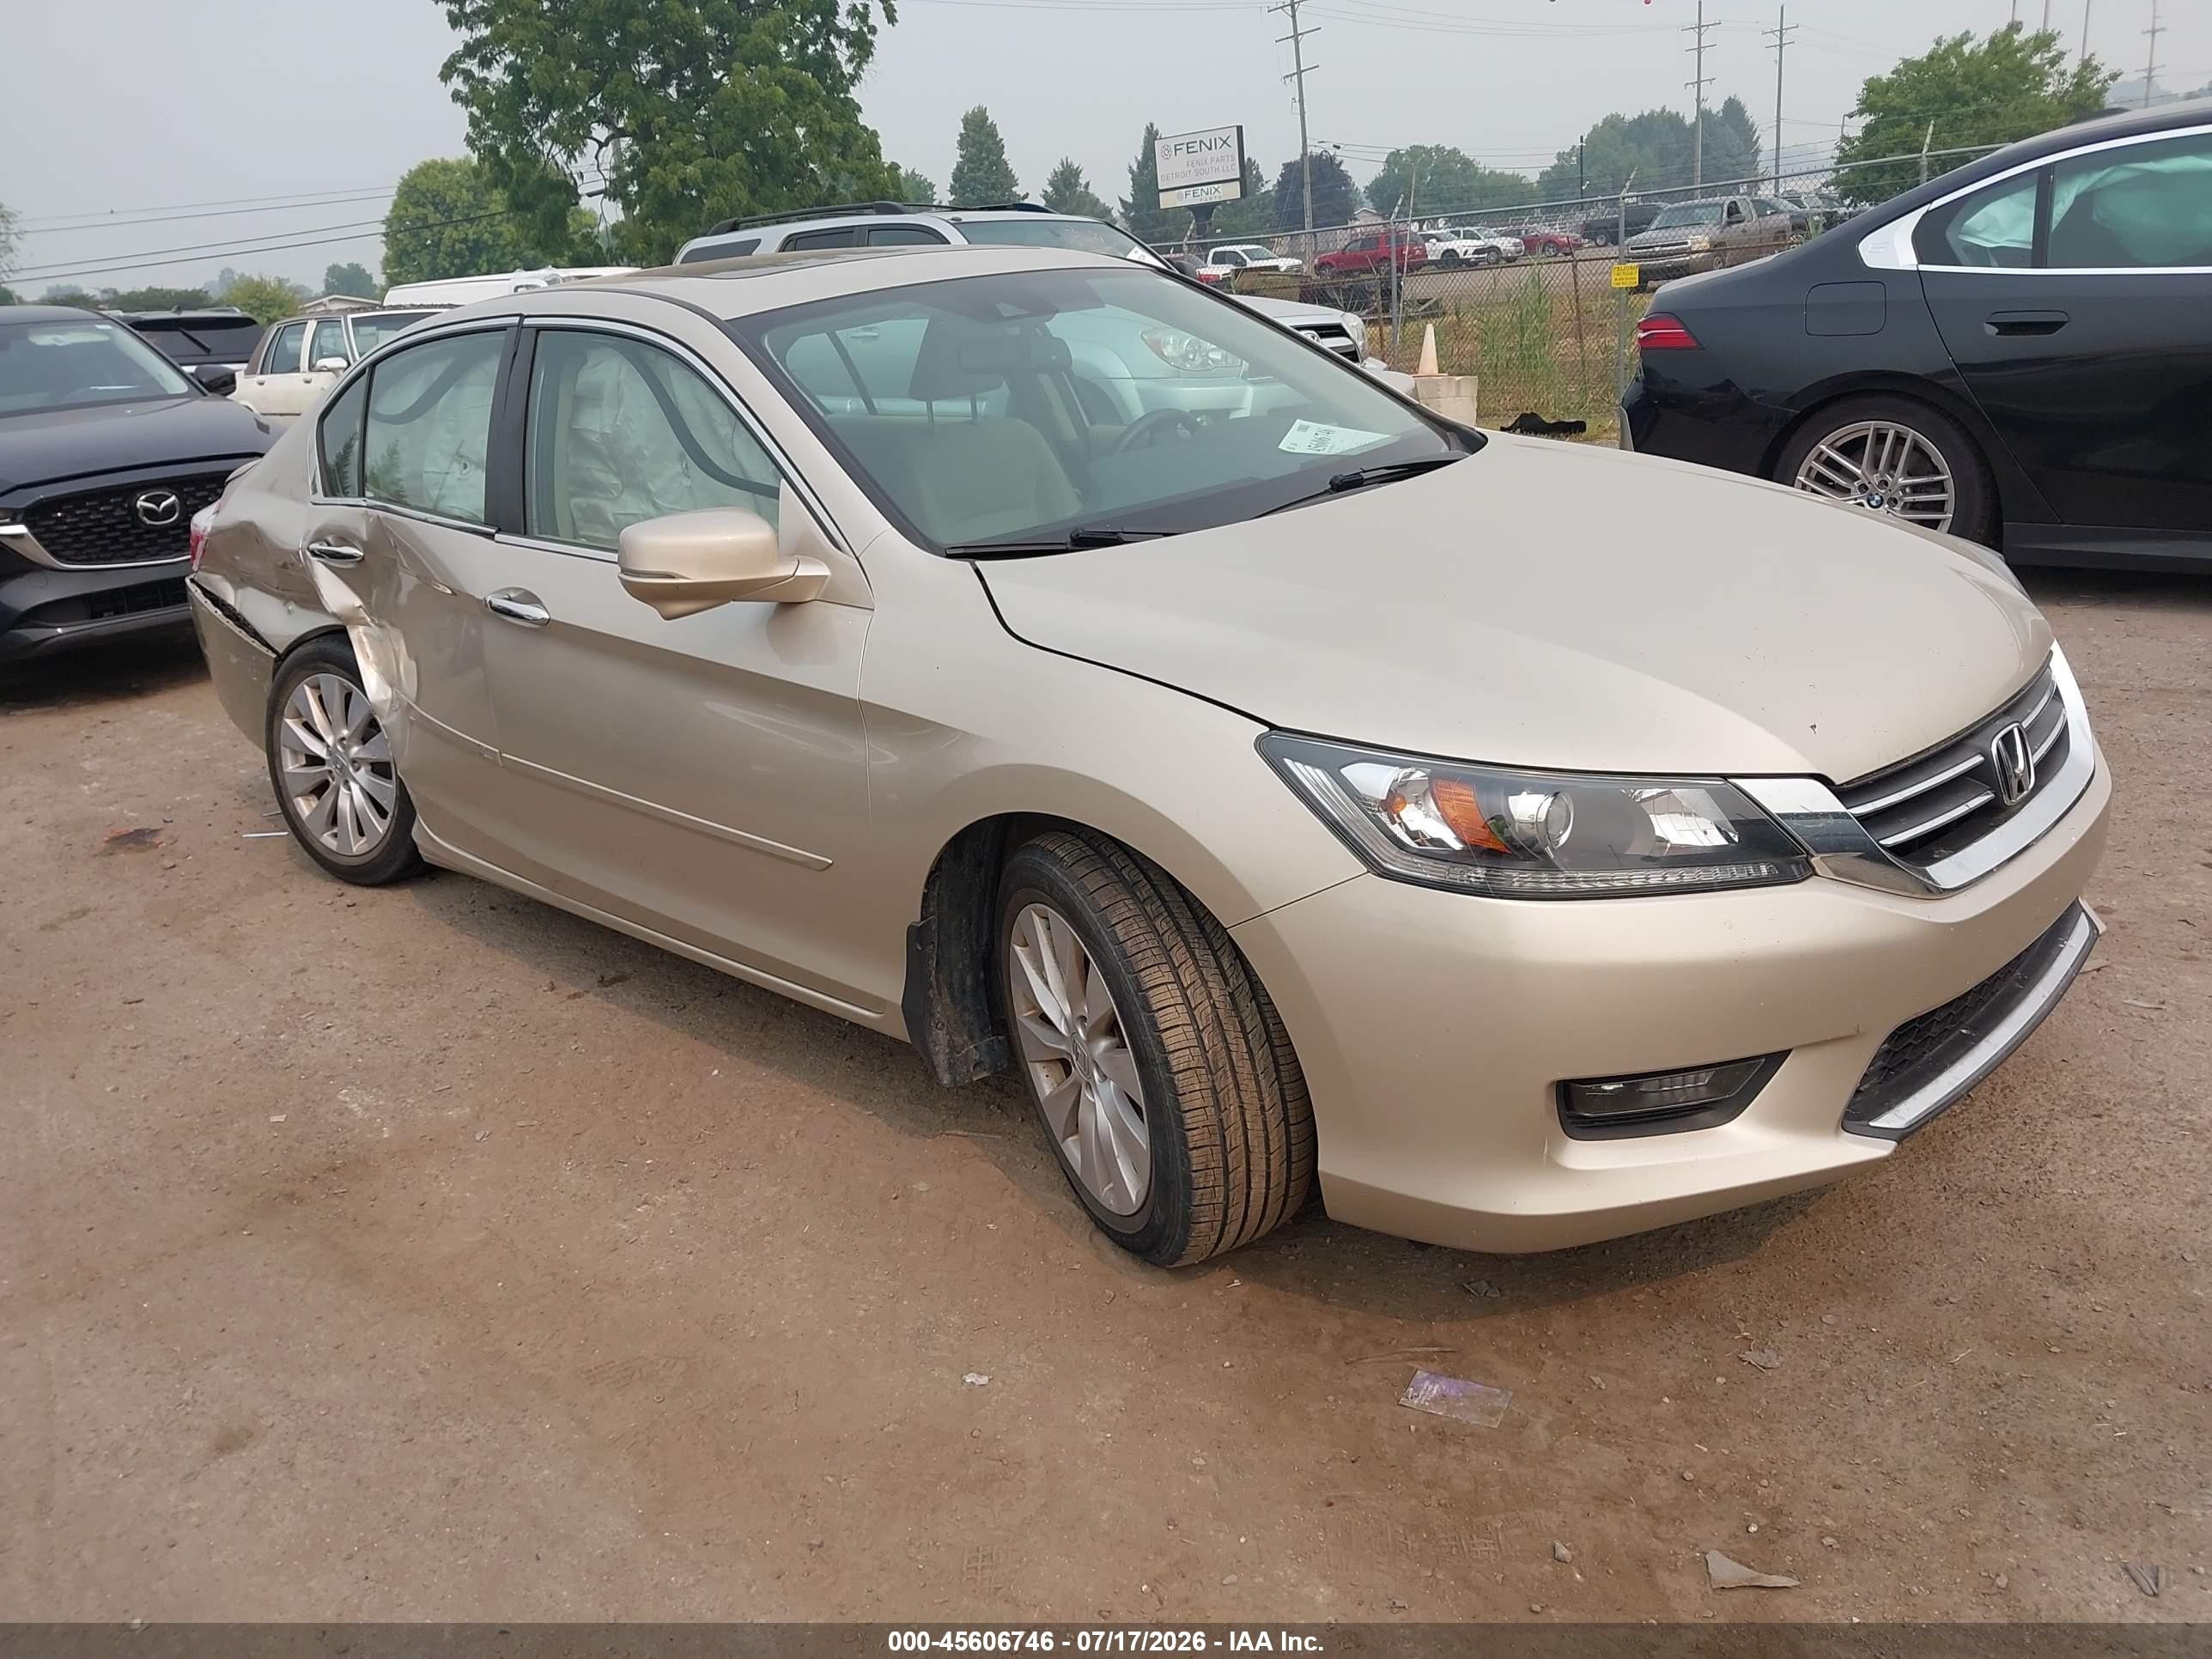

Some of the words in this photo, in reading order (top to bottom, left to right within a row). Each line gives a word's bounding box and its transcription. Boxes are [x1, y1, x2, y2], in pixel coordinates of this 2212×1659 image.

[1174, 135, 1231, 156] FENIX
[1187, 158, 1208, 167] FENIX
[1211, 154, 1236, 164] PARTS
[1161, 170, 1192, 182] DETROIT
[1194, 167, 1219, 177] SOUTH
[1222, 163, 1236, 173] LLC
[1184, 185, 1221, 199] FENIX
